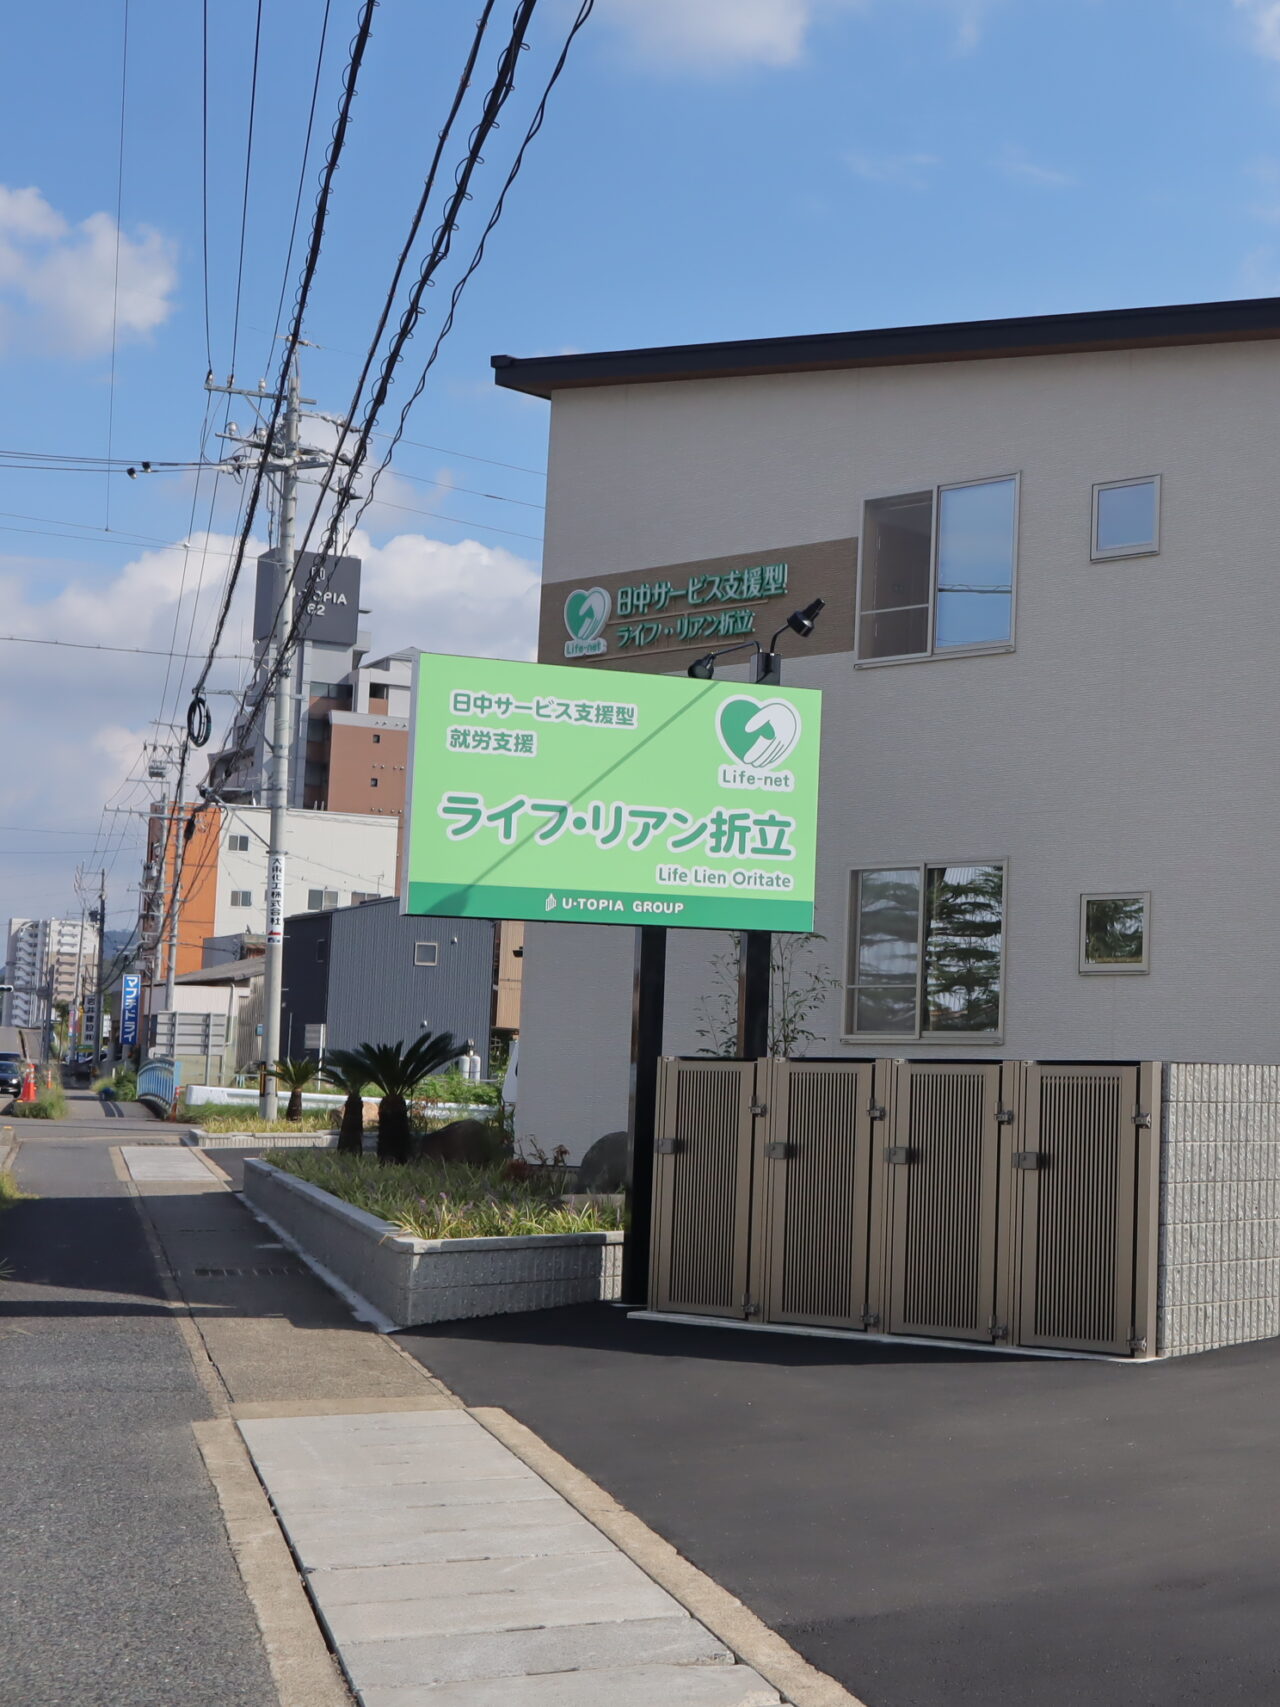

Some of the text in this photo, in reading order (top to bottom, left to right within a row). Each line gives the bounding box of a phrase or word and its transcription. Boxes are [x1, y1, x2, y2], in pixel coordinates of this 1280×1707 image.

[617, 563, 788, 617] 日中サービス支援型
[617, 608, 756, 649] ライフ・リアン折立
[566, 641, 602, 655] Life-net
[452, 693, 636, 727] 日中サービス支援型
[449, 728, 535, 755] 就労支援
[722, 768, 791, 788] Life-net
[441, 795, 793, 857] ライフ・リアン折立
[658, 868, 792, 889] Life Lien Oritate
[632, 900, 685, 915] GROUP
